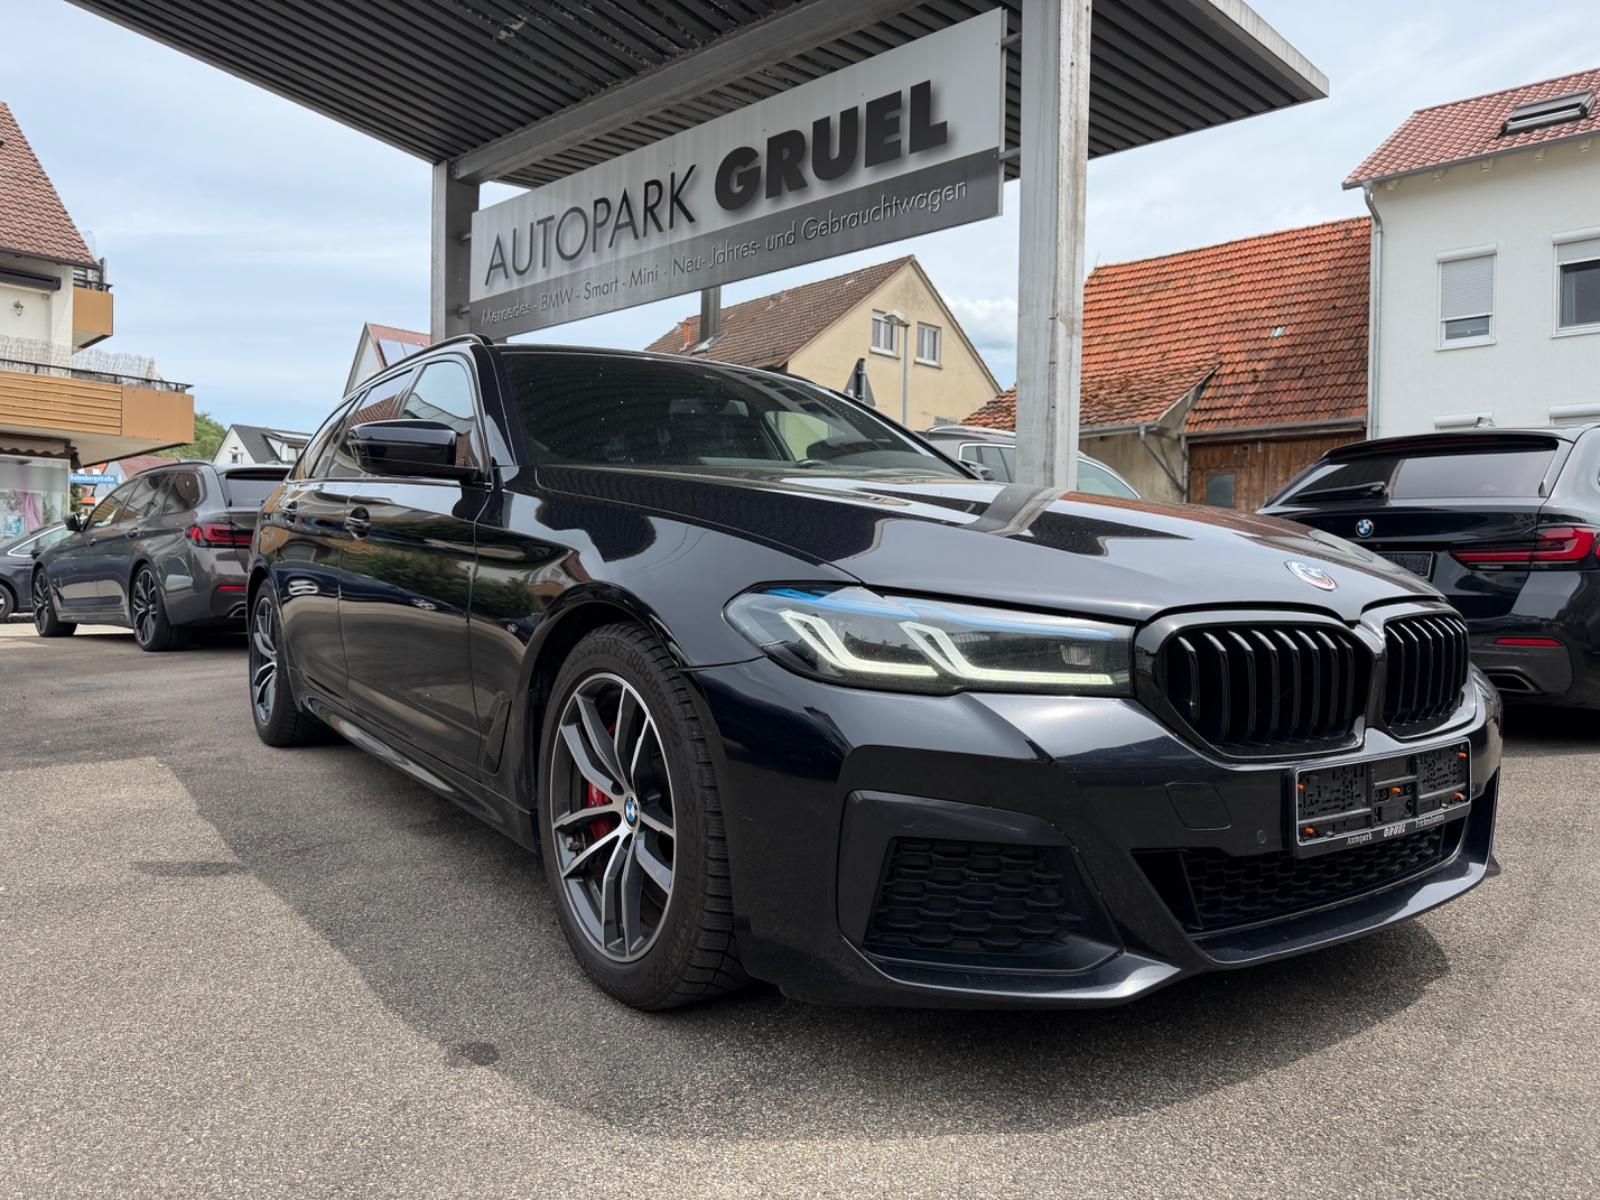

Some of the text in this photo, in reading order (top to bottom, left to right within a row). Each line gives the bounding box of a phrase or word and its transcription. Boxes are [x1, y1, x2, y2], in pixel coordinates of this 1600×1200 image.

[481, 298, 531, 327] Mercedes
[541, 287, 574, 312] BMW
[584, 279, 619, 300] Smart
[629, 264, 659, 288] Mini
[765, 220, 796, 251] und
[802, 180, 968, 241] Gebrauchtwagen
[484, 79, 949, 287] AUTOPARK GRUEL
